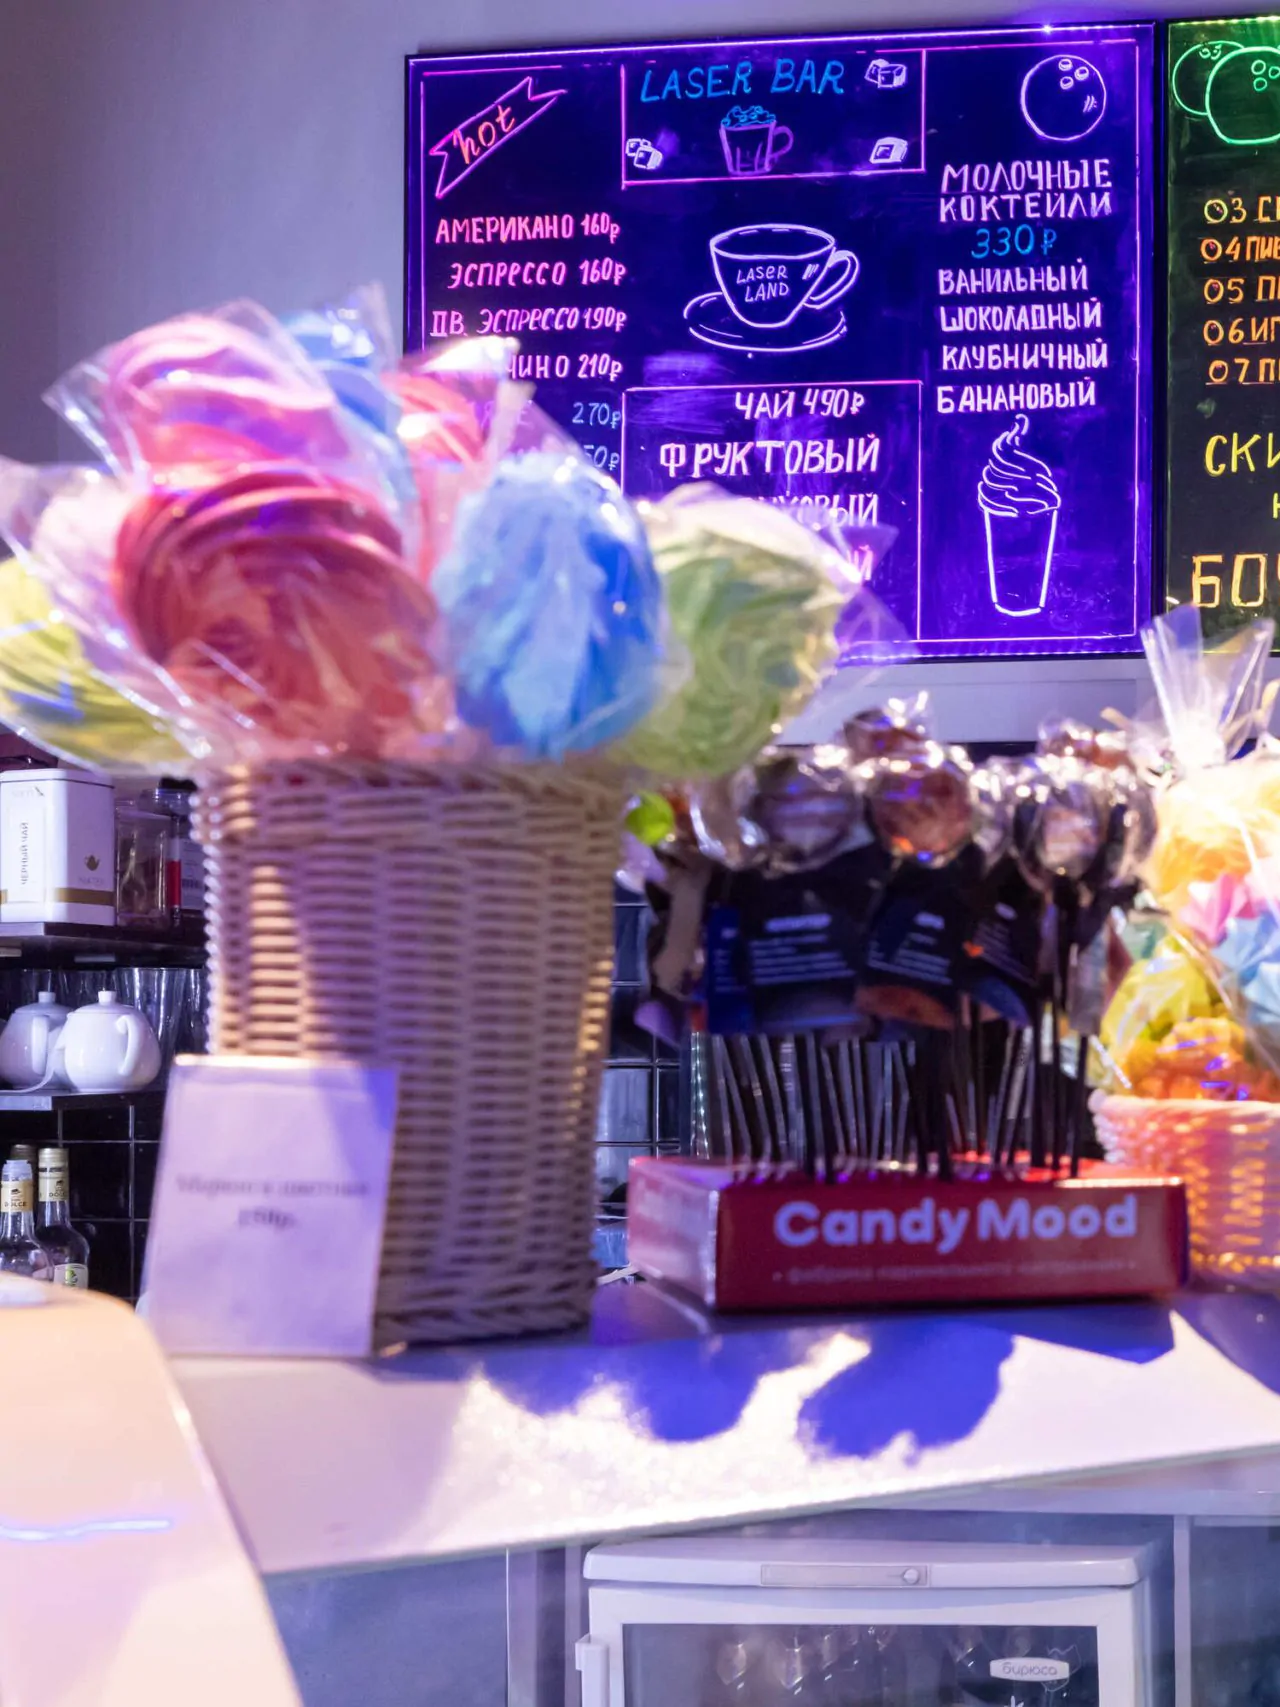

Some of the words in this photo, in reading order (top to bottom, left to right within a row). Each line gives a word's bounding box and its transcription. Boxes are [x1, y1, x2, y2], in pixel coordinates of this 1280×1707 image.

[641, 61, 751, 102] LASER
[770, 58, 844, 94] BAR
[940, 158, 1112, 195] МОЛОЧНЫЕ
[435, 214, 575, 244] АМЕРИКАНО
[744, 282, 790, 303] LAND
[938, 258, 1089, 295] ВАНИЛЬНЫЙ
[940, 297, 1102, 332] ШОКОЛАДНЫЙ
[506, 354, 570, 379] ЧИНО
[942, 338, 1108, 370] КЛУБНИЧНЫЙ
[734, 389, 795, 420] ЧАЙ
[937, 376, 1097, 414] БАНАНОВЫЙ
[660, 432, 881, 478] ФРУКТОВЫЙ
[773, 1197, 969, 1255] Candy
[977, 1194, 1138, 1241] Mood
